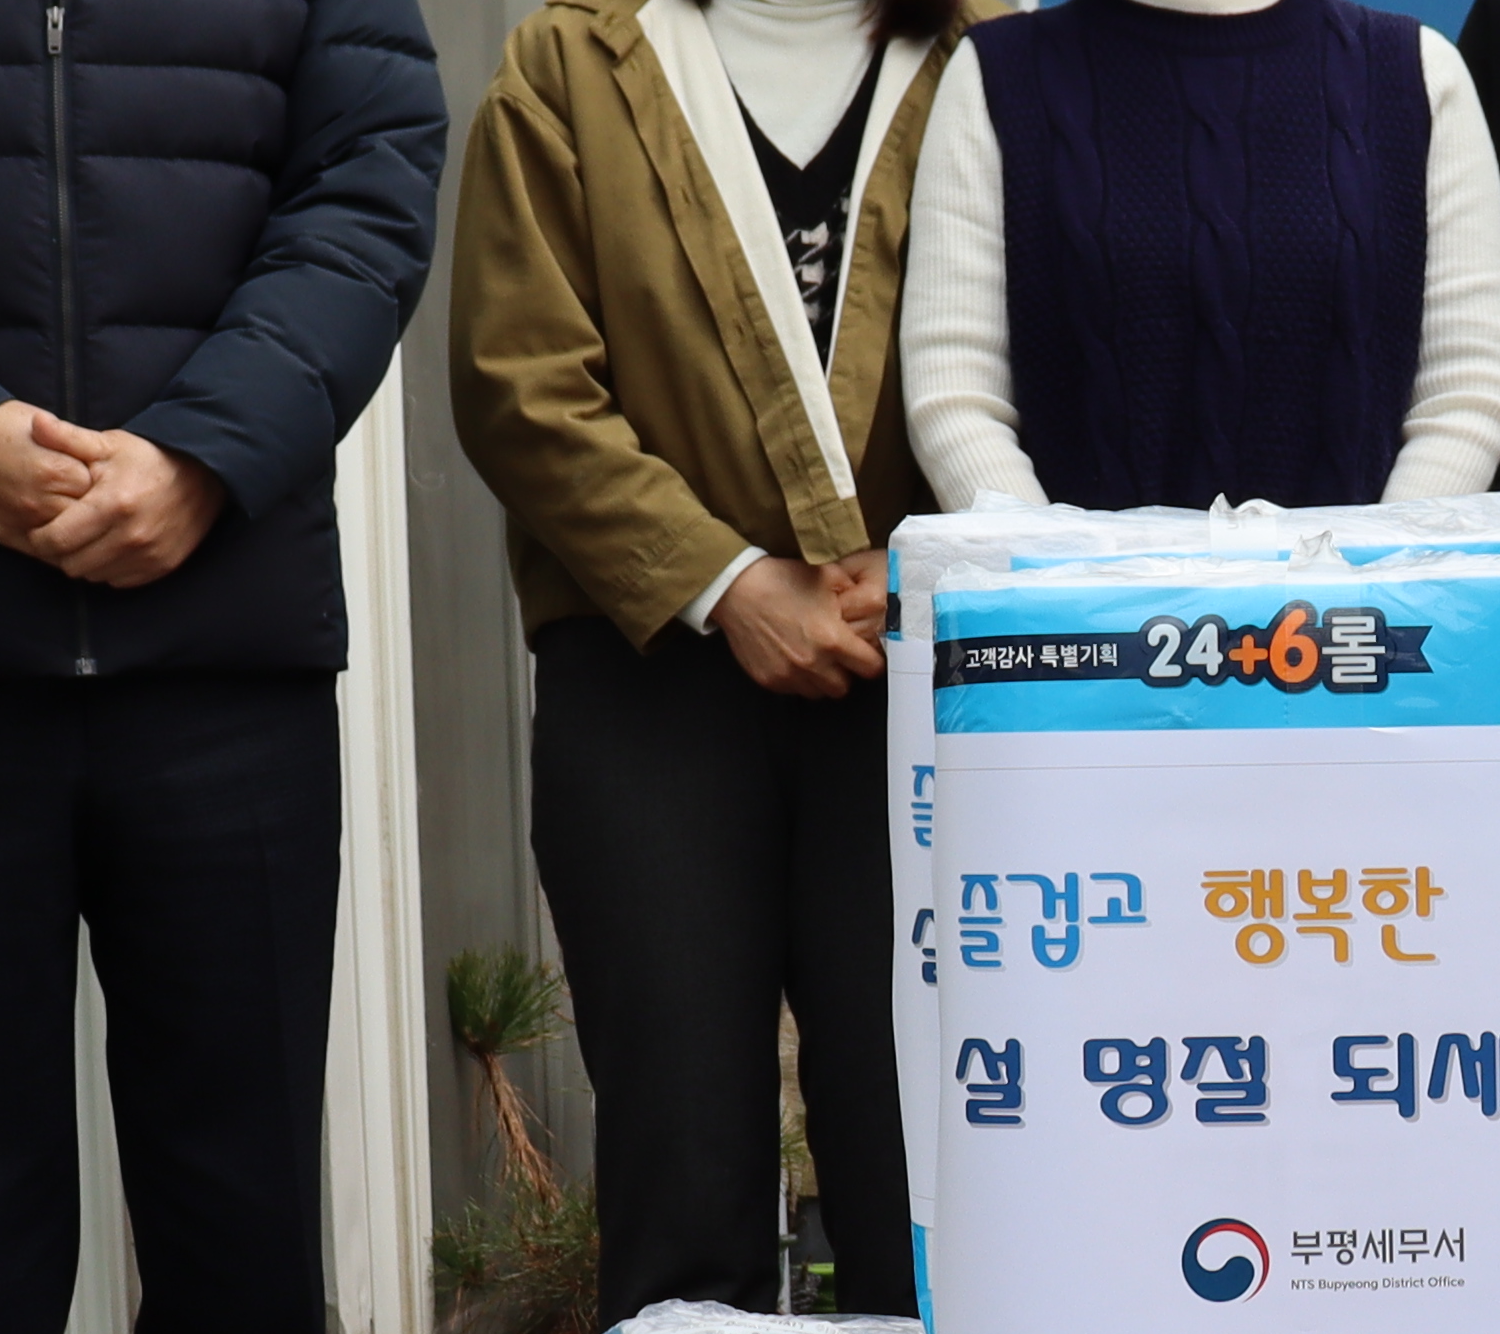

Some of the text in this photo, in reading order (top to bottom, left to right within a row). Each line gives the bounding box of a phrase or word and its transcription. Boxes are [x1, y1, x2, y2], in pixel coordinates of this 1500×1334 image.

[966, 646, 1034, 669] 고객감사
[1039, 643, 1118, 667] 특별기획
[958, 873, 1148, 969] 즐겁고
[1201, 865, 1446, 966] 행복한
[955, 1038, 1025, 1127] 설
[1083, 1035, 1270, 1127] 명절
[1291, 1228, 1465, 1265] 부평세무서
[1291, 1276, 1465, 1292] NTS Bupyeong District Office
